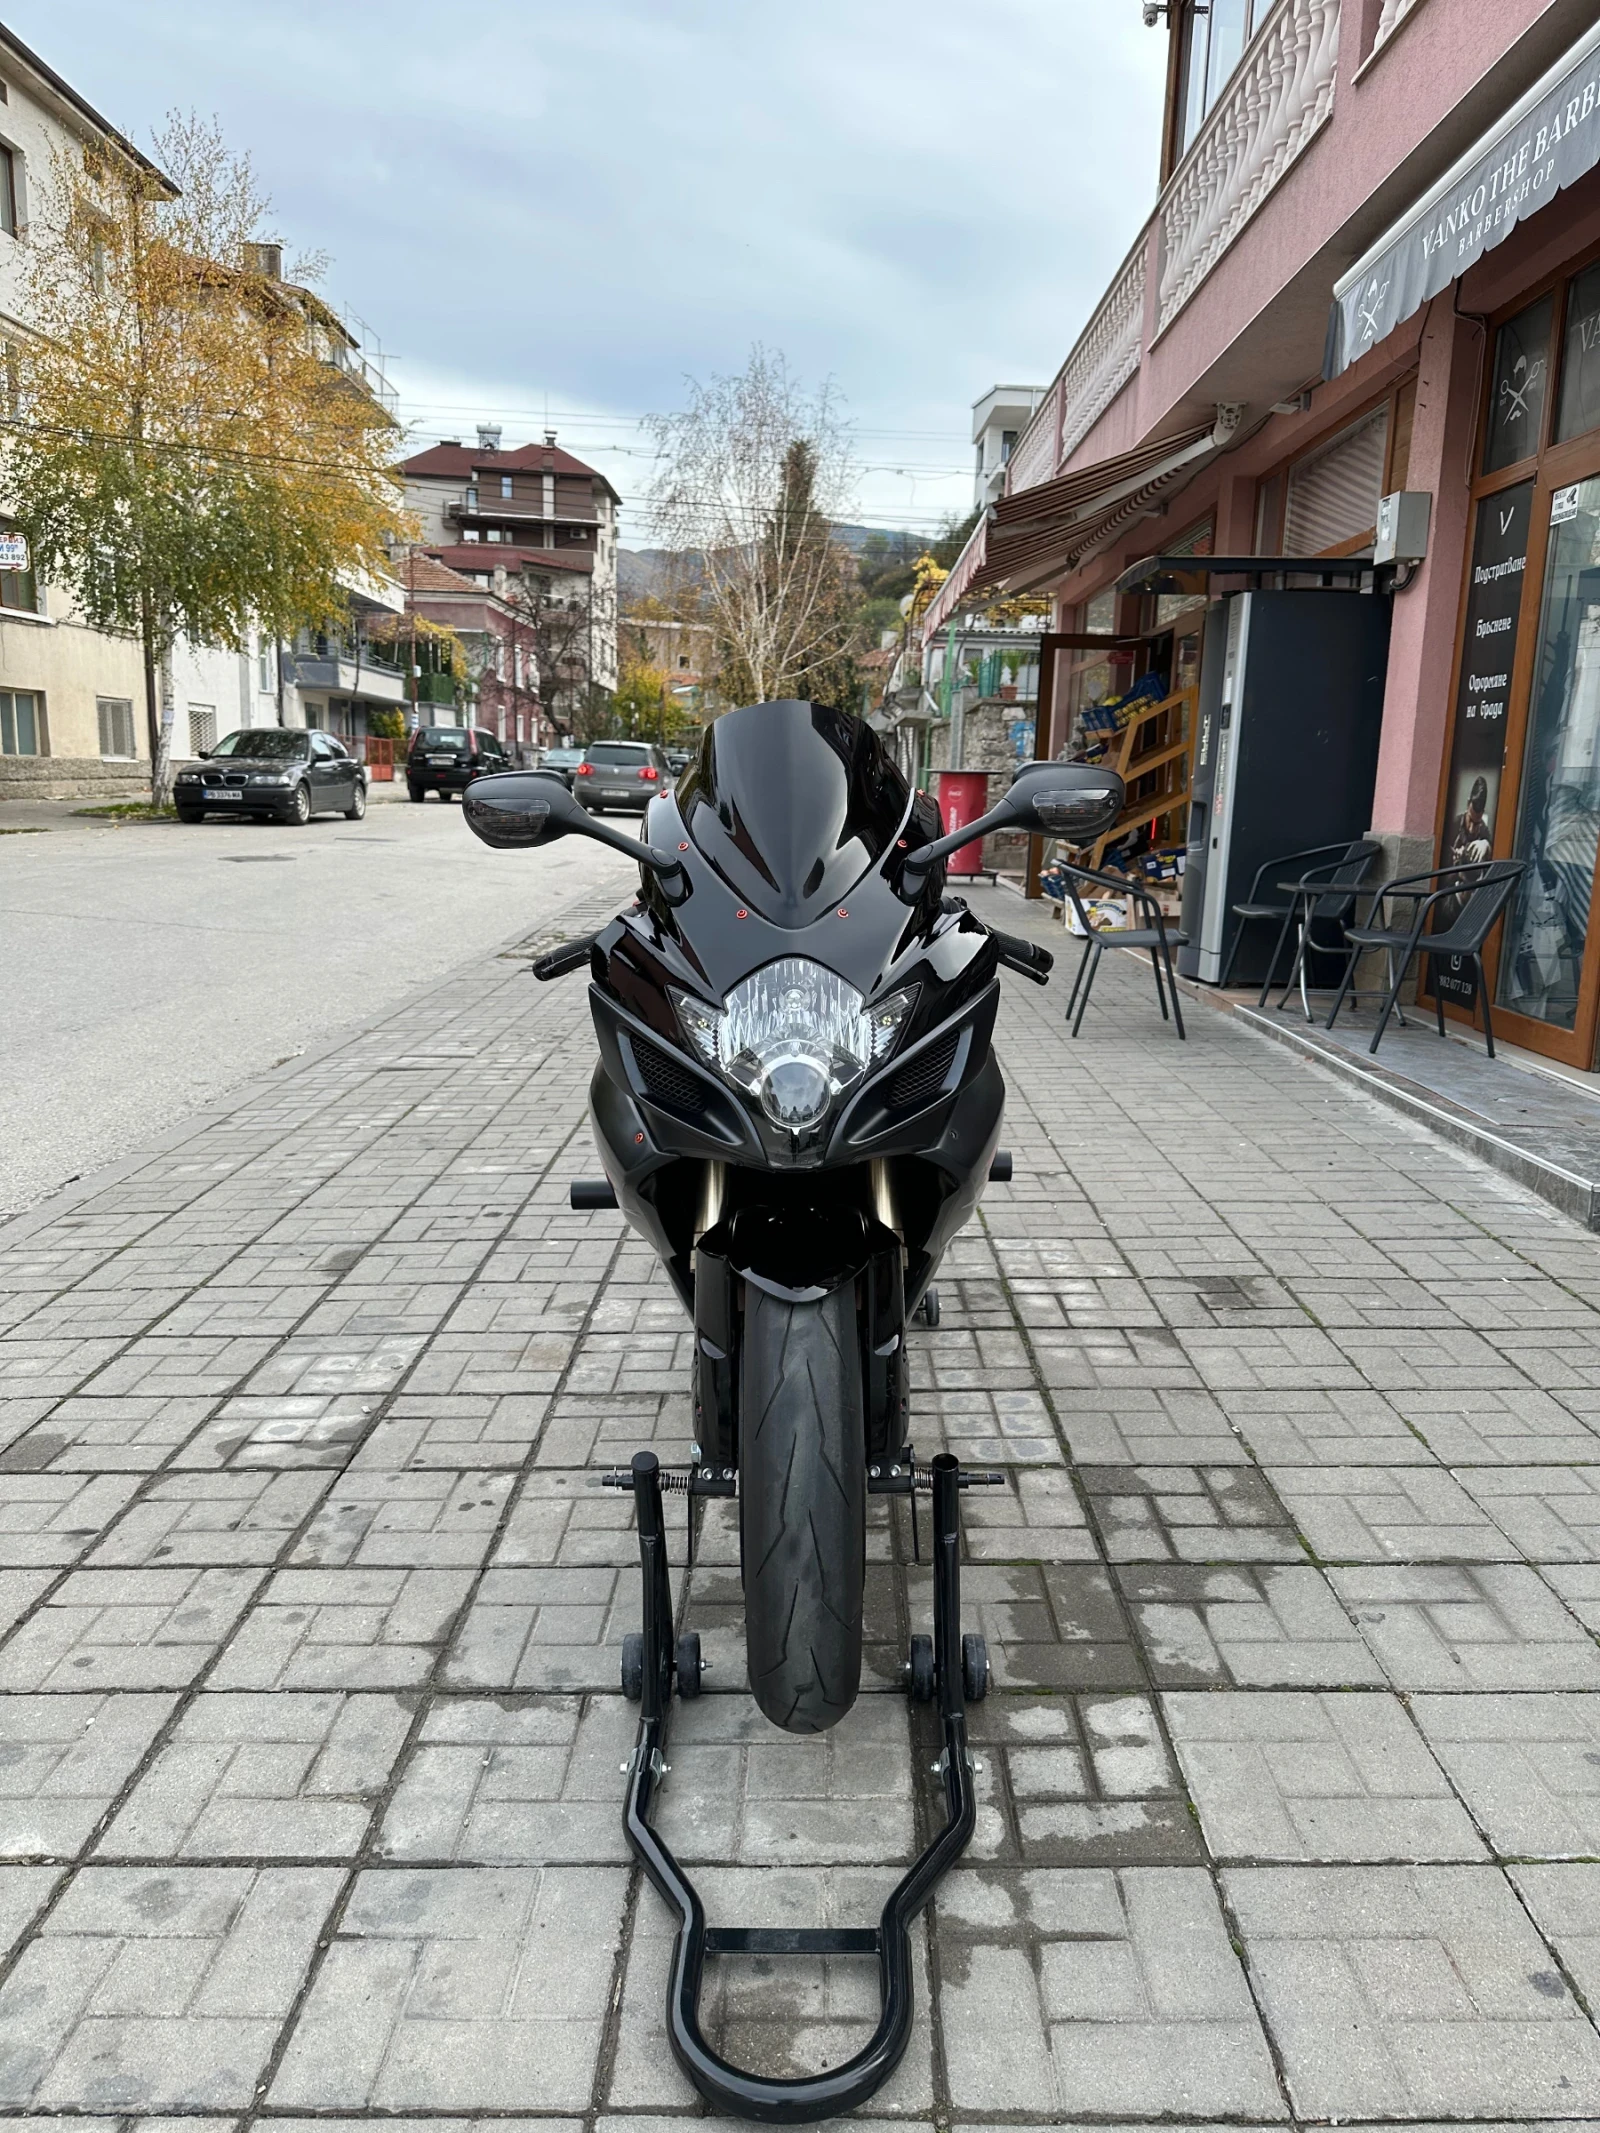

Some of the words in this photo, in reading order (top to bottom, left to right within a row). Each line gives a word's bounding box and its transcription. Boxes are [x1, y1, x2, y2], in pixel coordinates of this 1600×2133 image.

[1422, 184, 1486, 259] VANKO
[1490, 140, 1531, 202] THE
[1458, 158, 1555, 257] BARBERSHOP
[1474, 556, 1527, 584] Подстригване
[1476, 617, 1512, 638] Бръснене
[1469, 674, 1507, 693] Оформяне
[1466, 705, 1477, 718] на
[1480, 700, 1503, 719] брада
